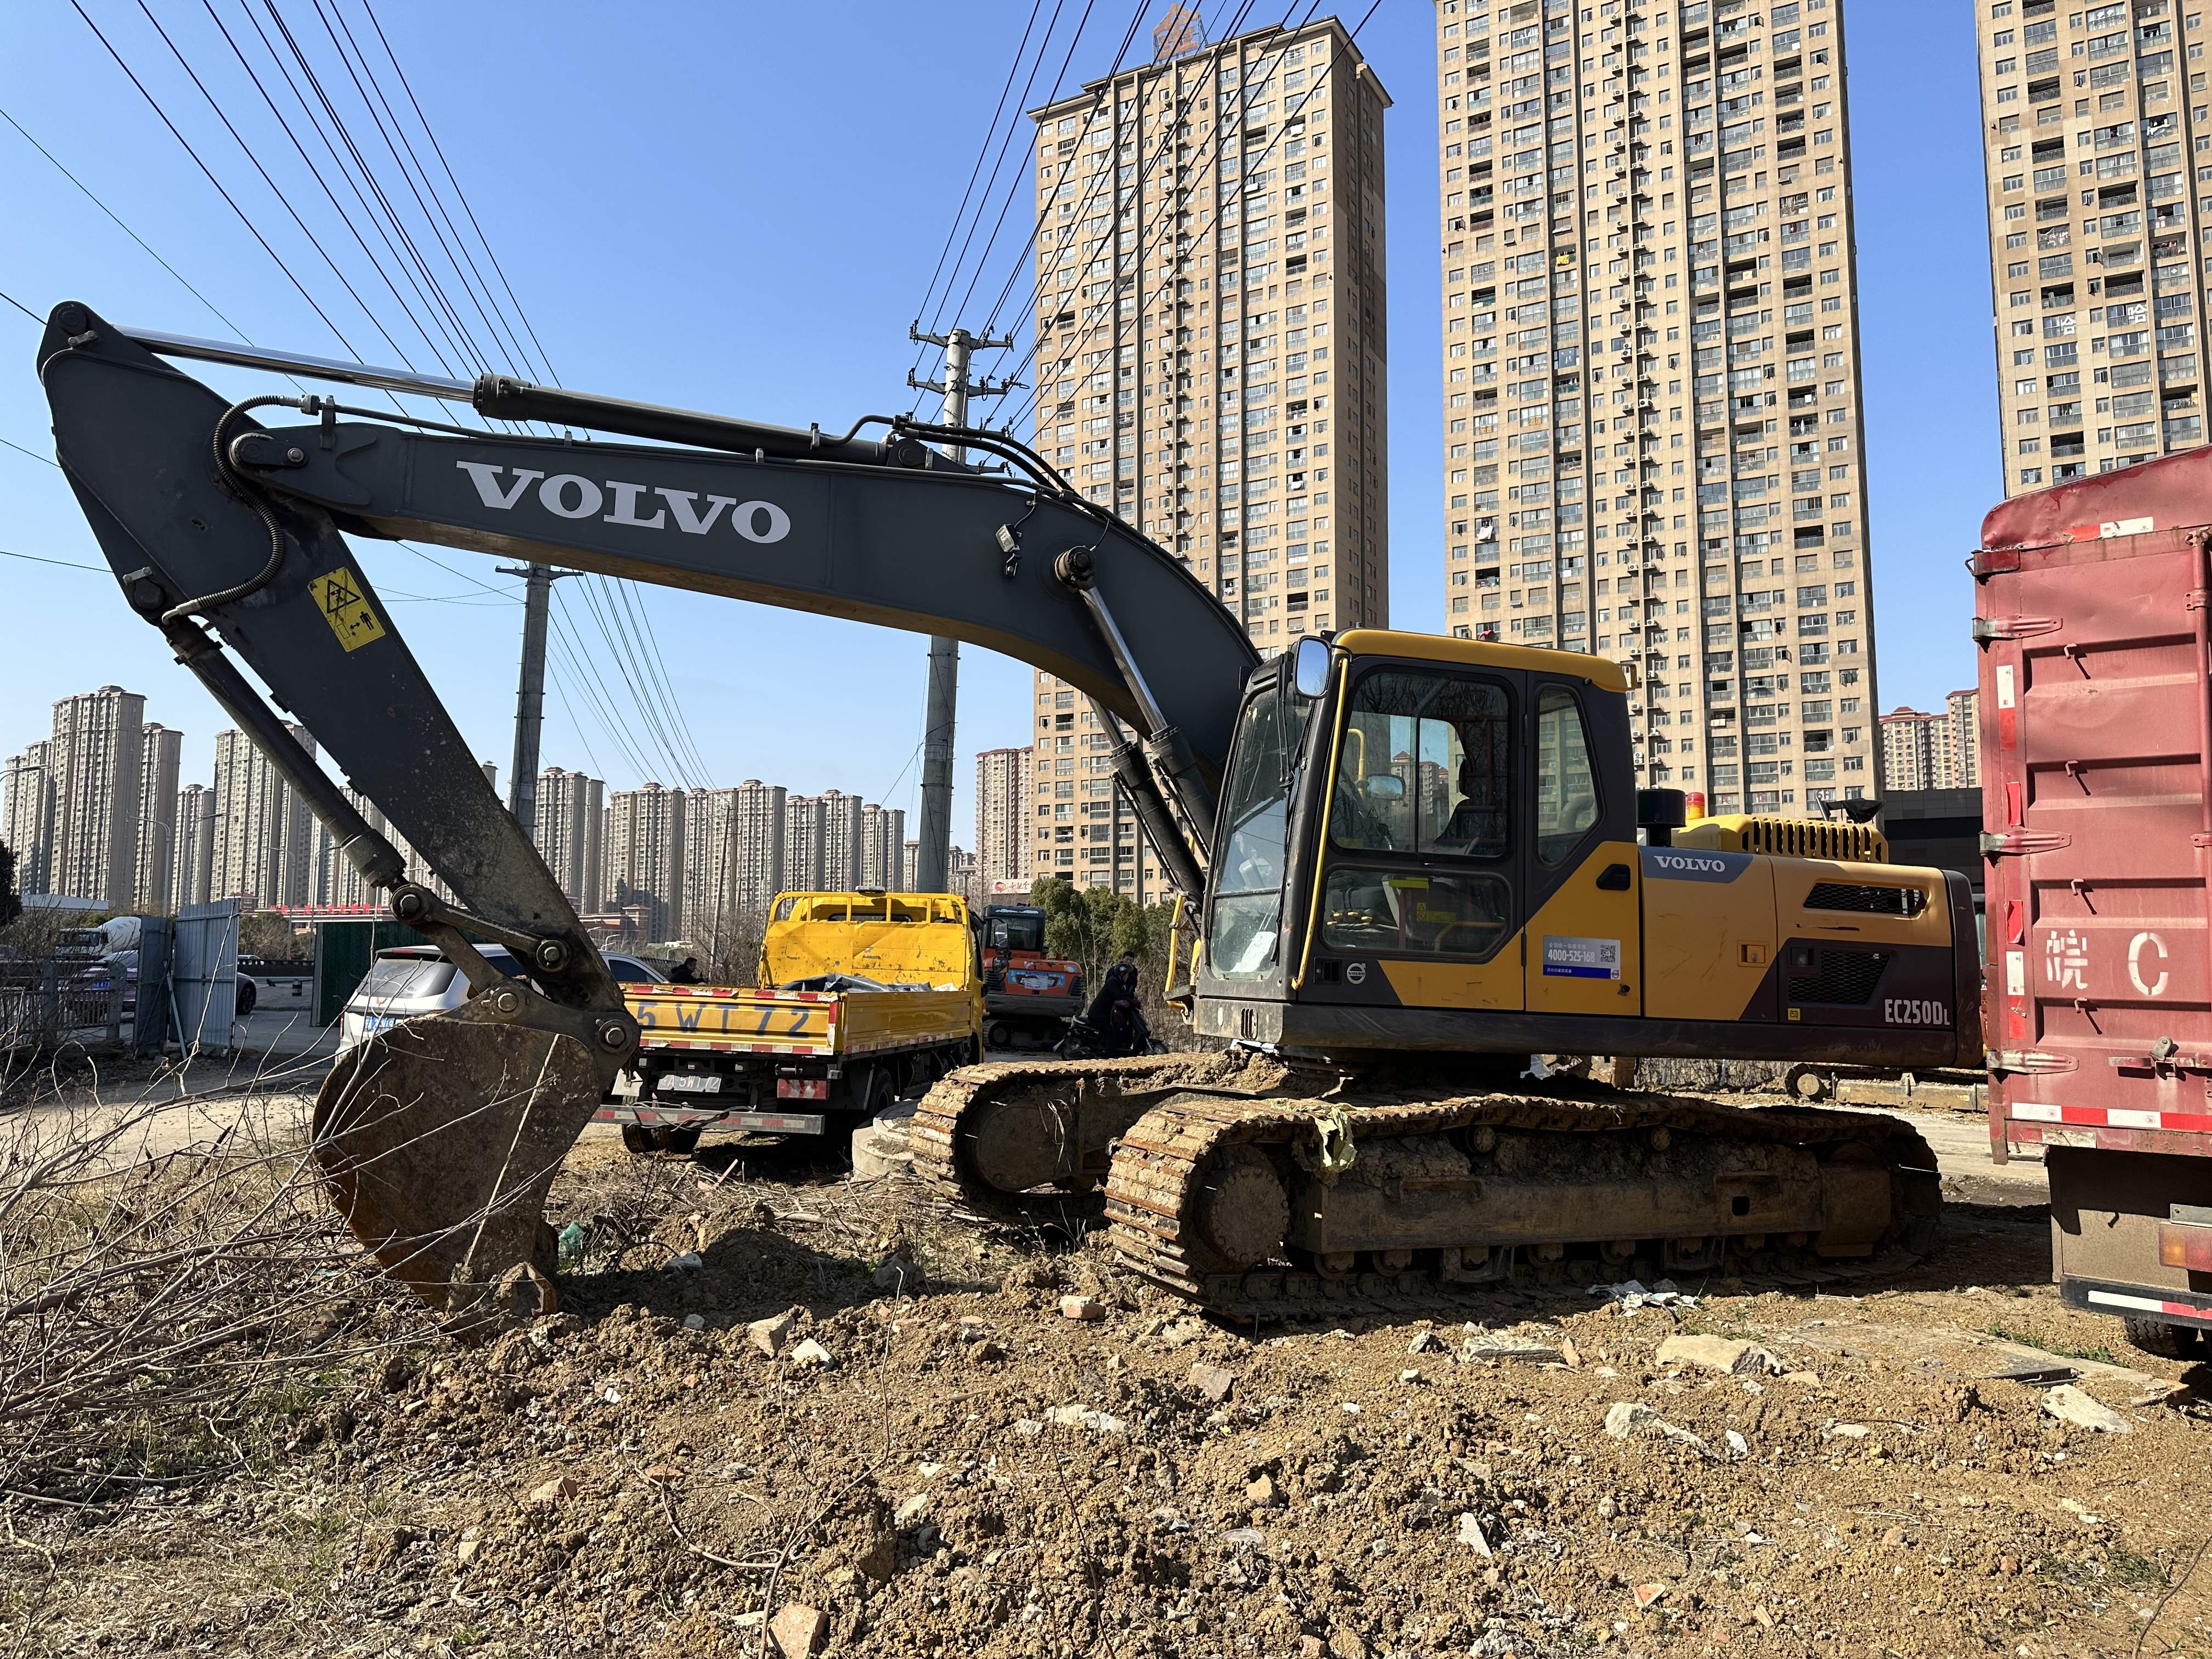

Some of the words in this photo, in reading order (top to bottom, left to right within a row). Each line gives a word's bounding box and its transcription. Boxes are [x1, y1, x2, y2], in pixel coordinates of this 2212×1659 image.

[456, 460, 791, 544] VOLVO
[1654, 855, 1725, 872] VOLVO
[1548, 949, 1595, 962] 4000-525-168
[2046, 929, 2088, 990] 皖
[2128, 932, 2169, 995] C
[1884, 999, 1950, 1025] EC250DL
